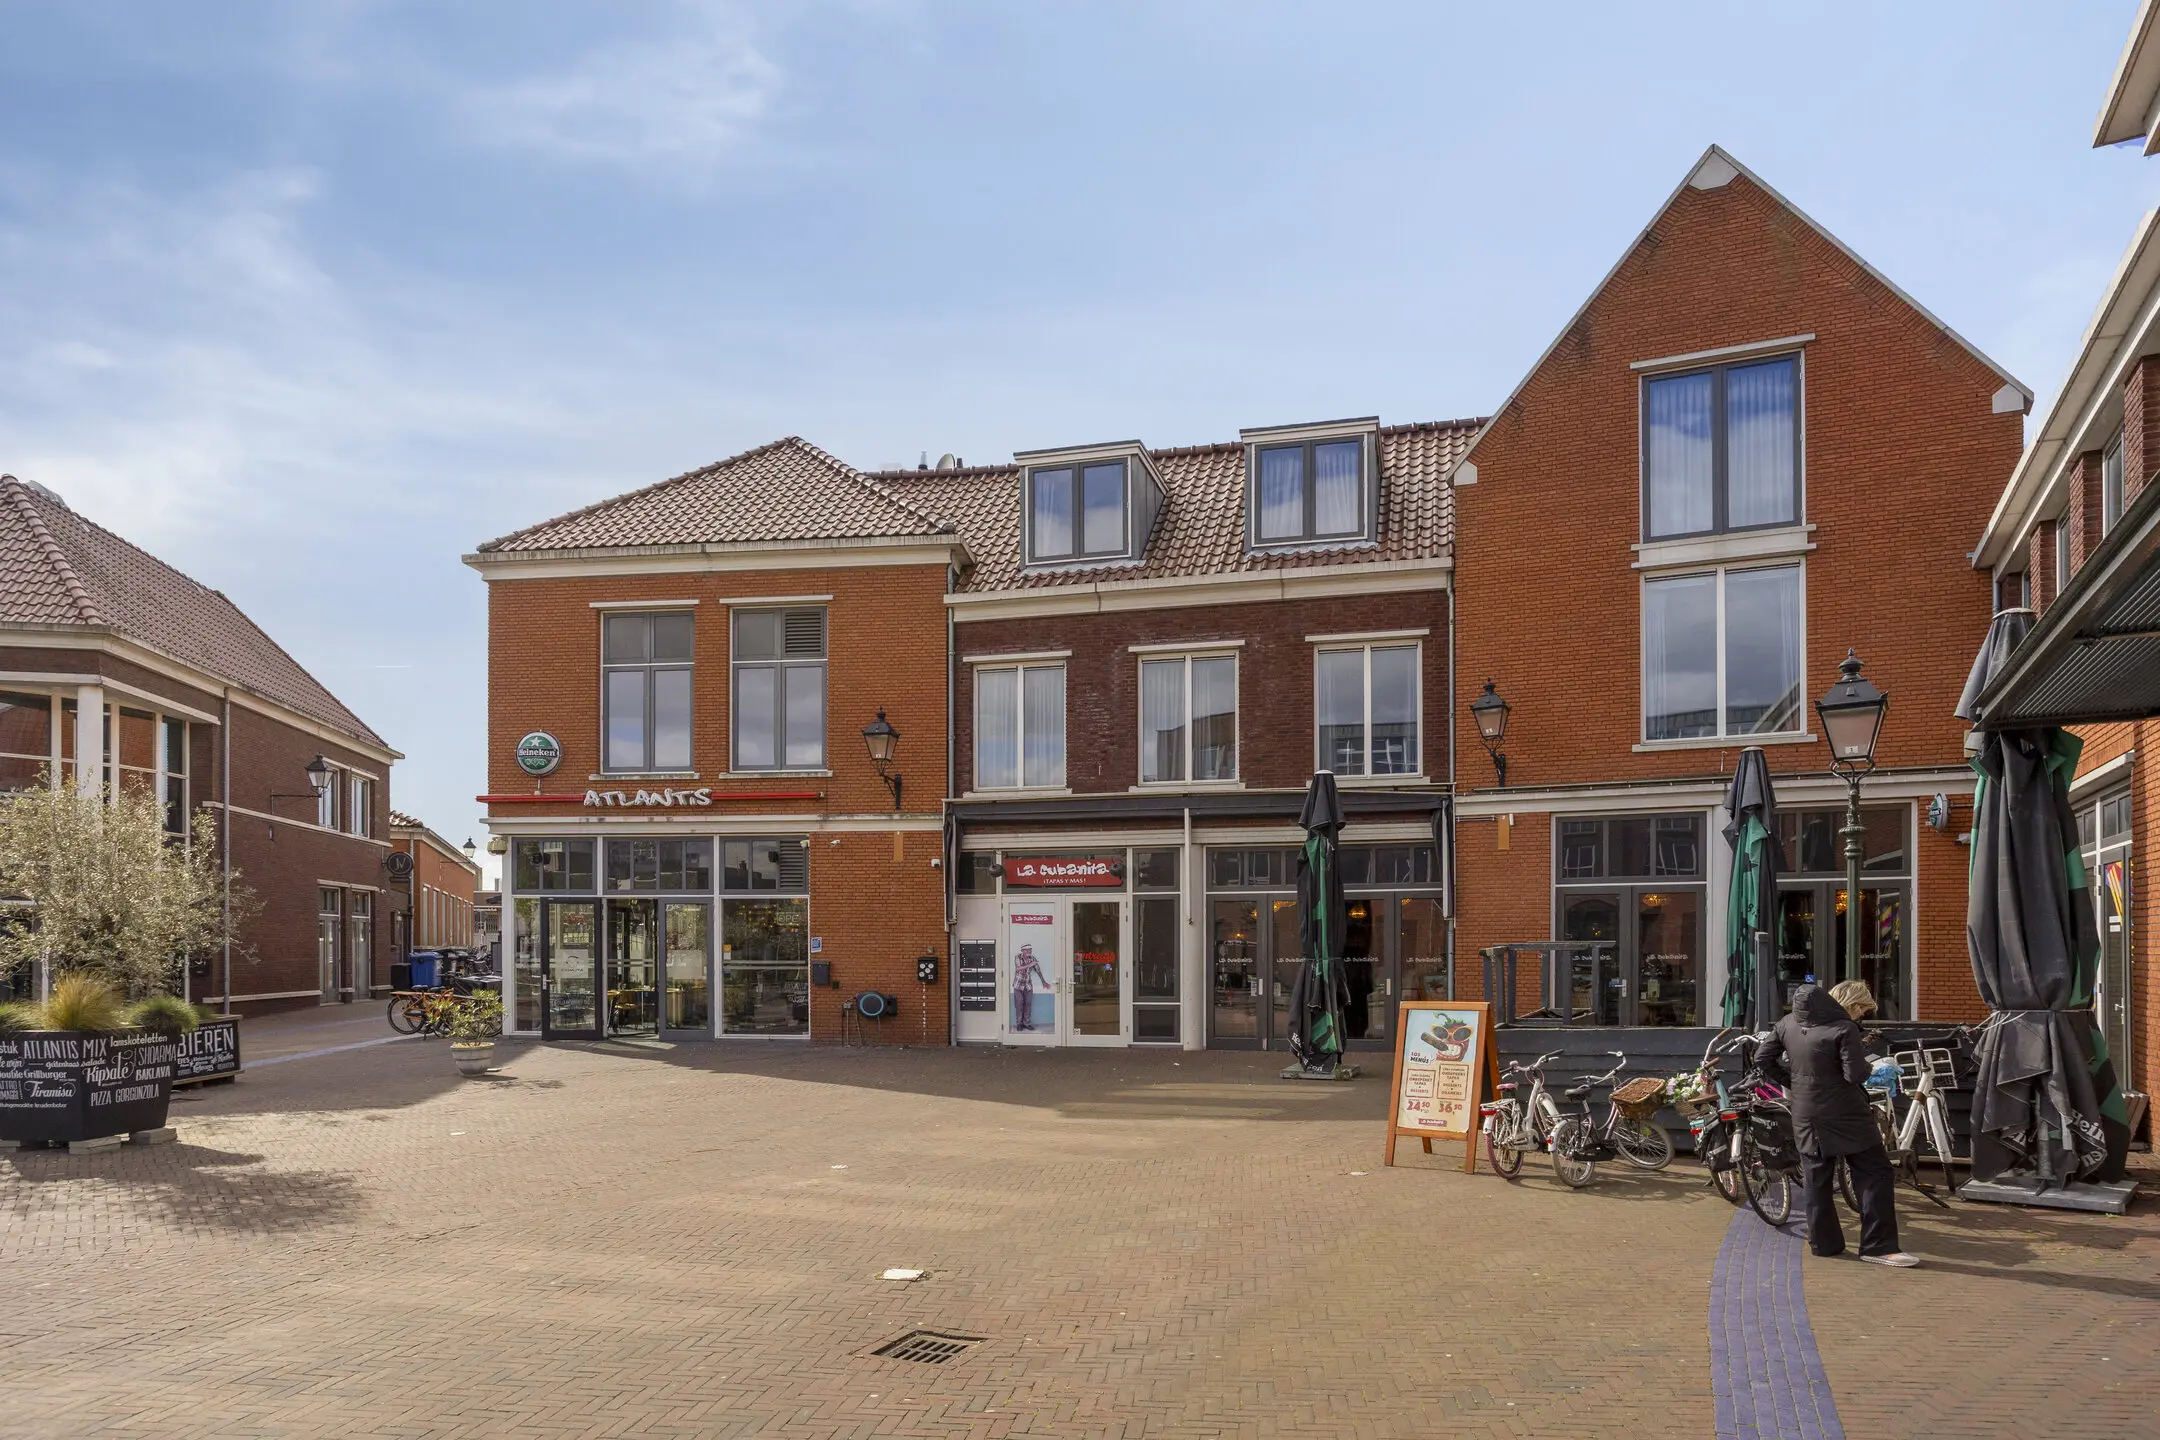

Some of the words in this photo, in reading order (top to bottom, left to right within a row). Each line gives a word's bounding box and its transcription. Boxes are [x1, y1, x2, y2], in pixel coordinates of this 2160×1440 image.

[23, 1040, 79, 1060] ATLANTIS
[82, 1038, 107, 1059] MIX
[176, 1027, 234, 1058] BIEREN
[138, 1043, 177, 1066] SHOARMA
[135, 1065, 171, 1081] BAKLAVA
[23, 1080, 76, 1098] Tiramisu
[90, 1090, 112, 1107] PIZZA
[115, 1083, 160, 1103] GORGONZOLA
